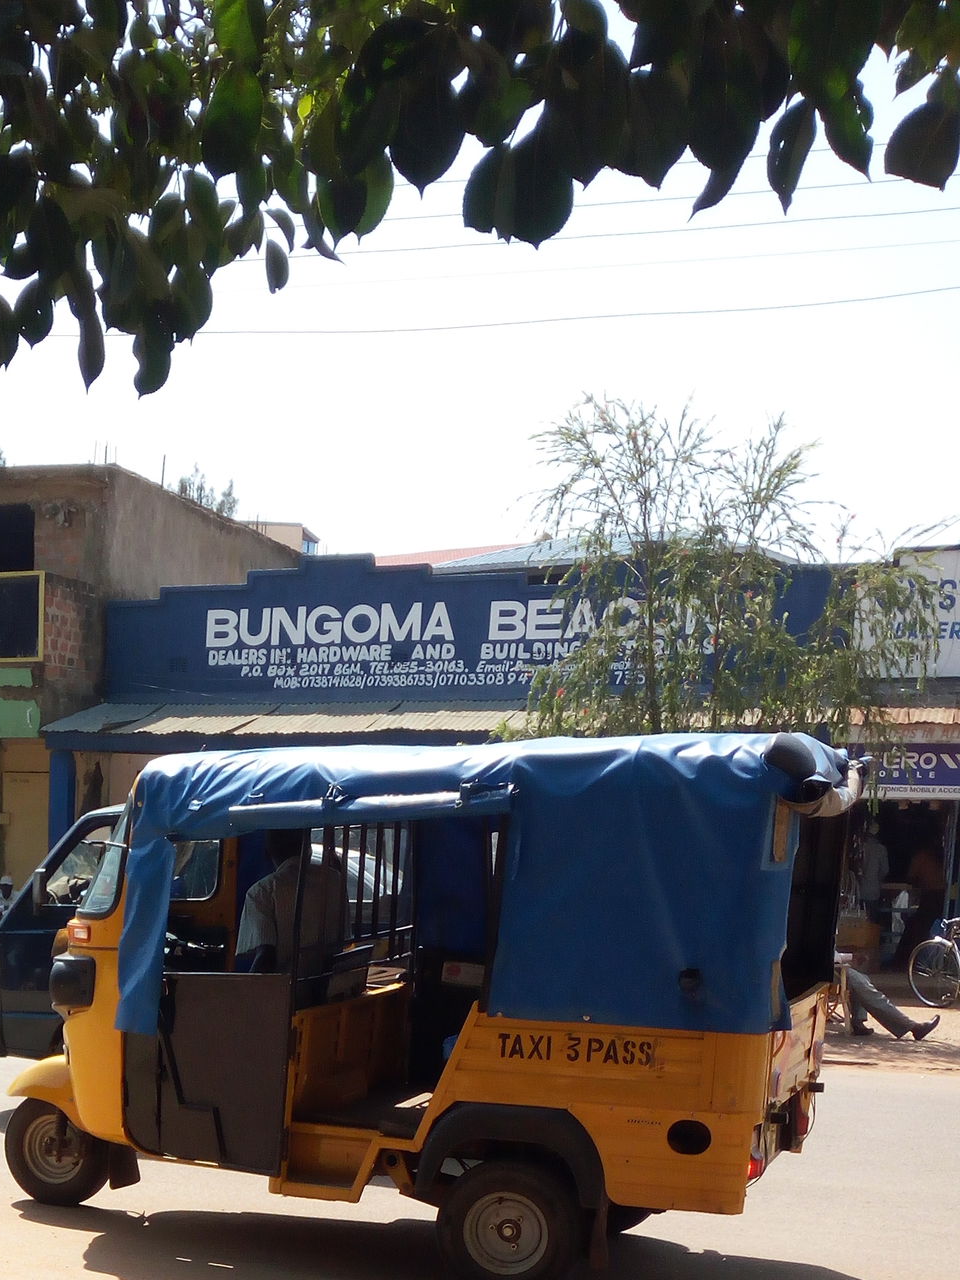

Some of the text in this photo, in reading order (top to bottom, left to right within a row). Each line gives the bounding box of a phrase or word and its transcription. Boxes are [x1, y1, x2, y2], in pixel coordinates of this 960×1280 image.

[206, 602, 455, 647] BUNGOMA
[208, 649, 267, 665] DEALERS
[296, 644, 392, 663] HARDWARE
[411, 643, 456, 660] AND
[240, 666, 263, 677] P.O.
[266, 665, 296, 676] Box
[299, 664, 331, 676] 2017
[909, 786, 936, 794] MOBILE
[498, 1033, 552, 1061] TAXI
